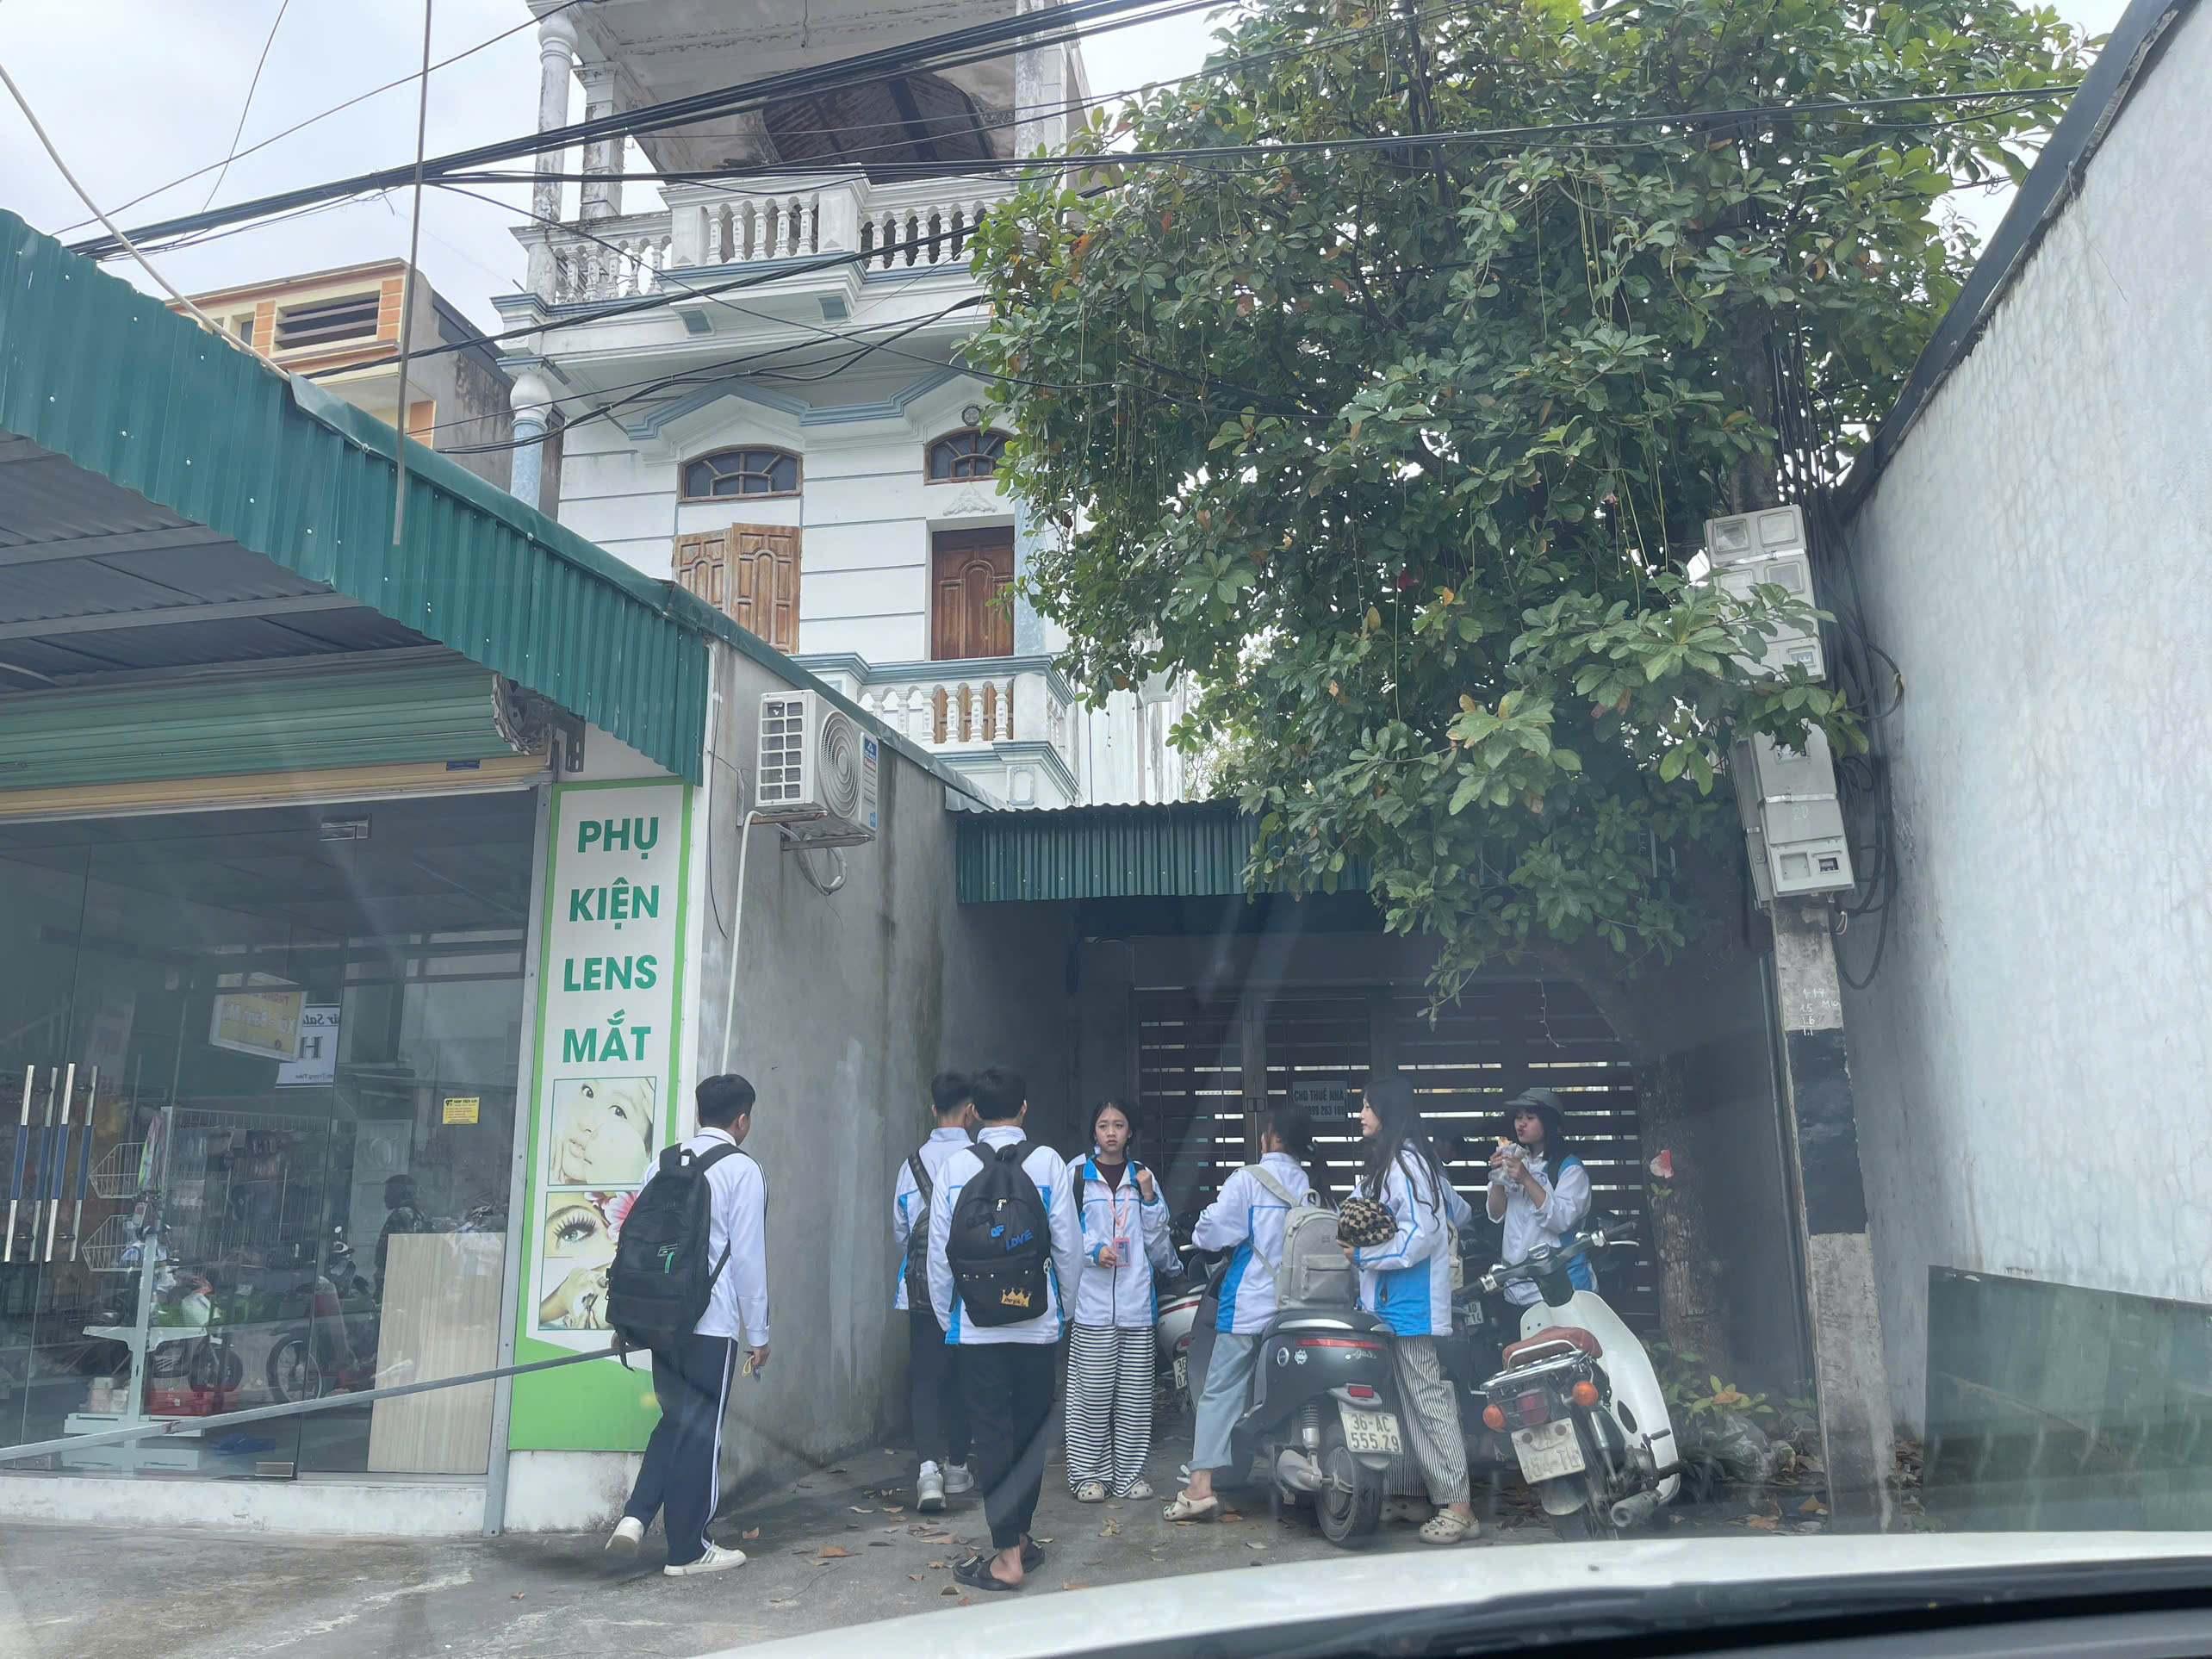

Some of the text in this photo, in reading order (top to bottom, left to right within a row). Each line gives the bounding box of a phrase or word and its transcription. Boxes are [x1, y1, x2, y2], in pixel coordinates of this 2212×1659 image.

[577, 817, 660, 861] PHỤ
[569, 876, 660, 930] KIỆN
[562, 954, 658, 992] LENS
[562, 1009, 652, 1063] MẮT
[1294, 1090, 1308, 1103] CHO
[1309, 1086, 1327, 1102] THUÊ
[1005, 1229, 1034, 1252] LOVE
[1351, 1413, 1391, 1433] 36-AC
[1351, 1432, 1401, 1453] 555.29
